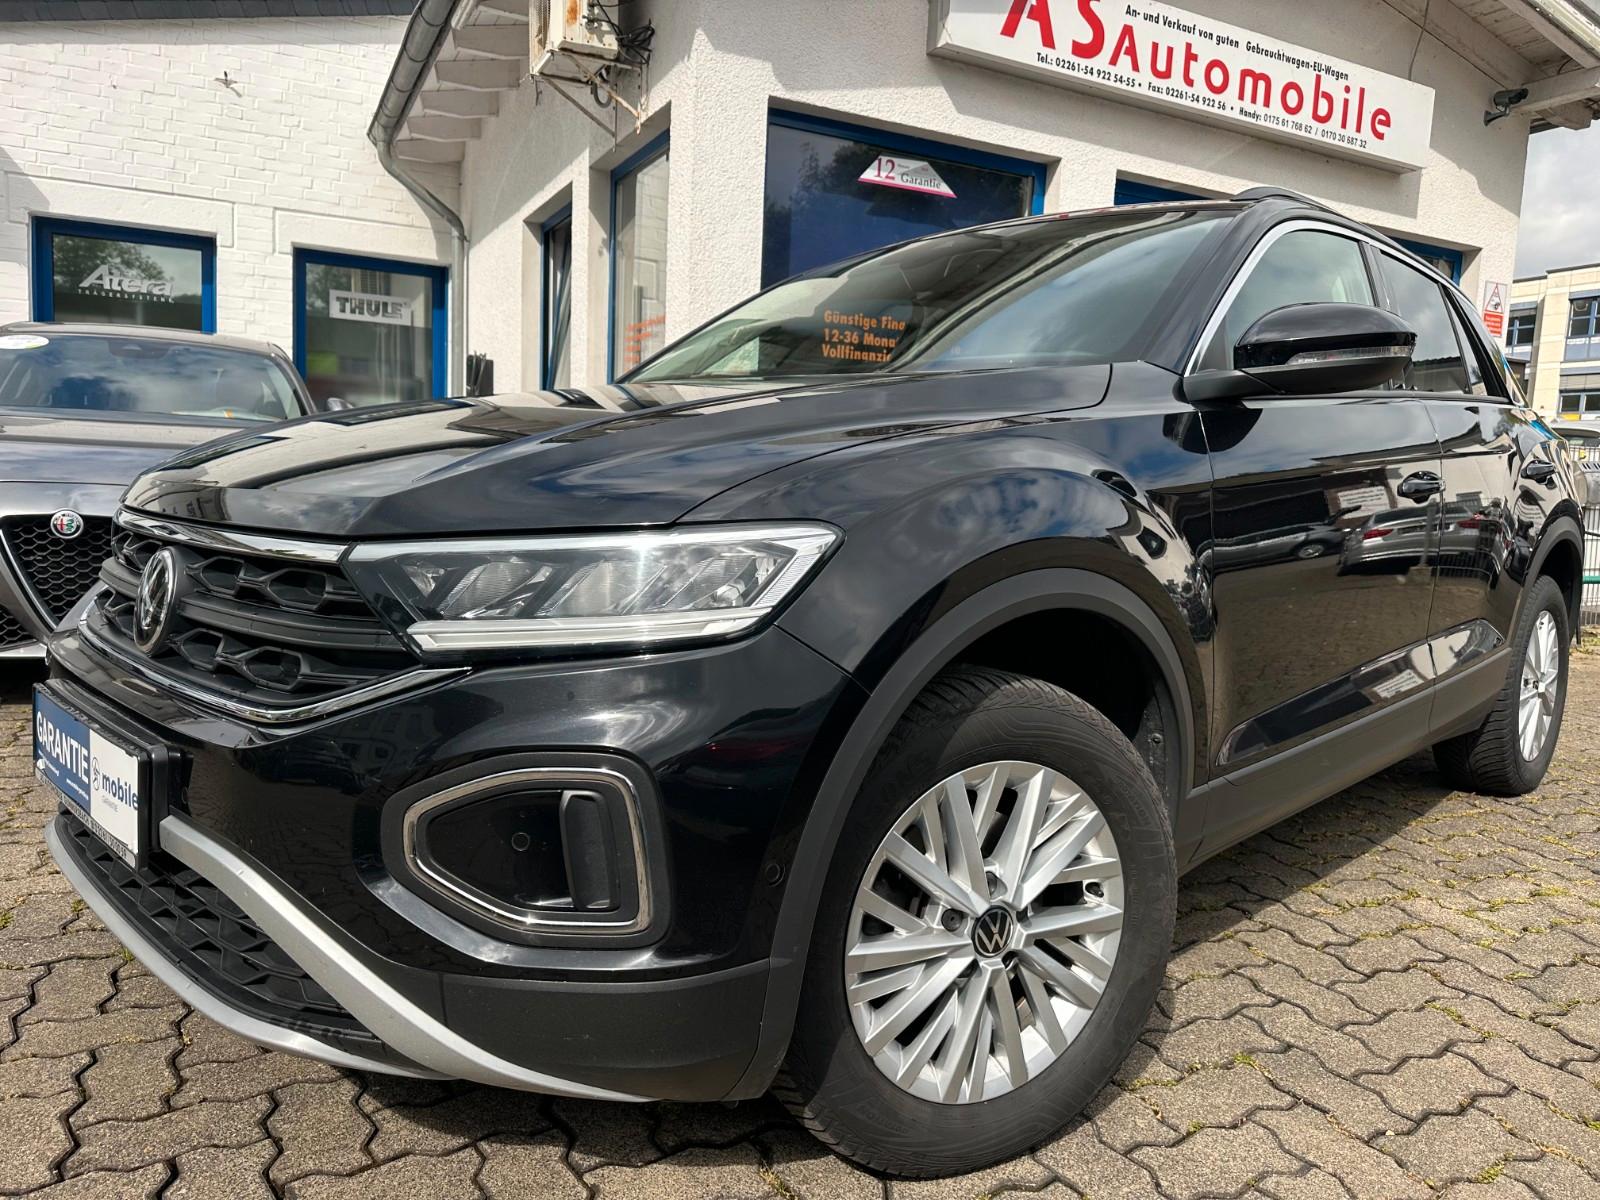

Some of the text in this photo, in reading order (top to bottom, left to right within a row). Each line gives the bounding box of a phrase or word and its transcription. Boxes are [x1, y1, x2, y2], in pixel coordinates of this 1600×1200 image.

[1125, 4, 1350, 81] An- und Verkauf von guten Gebrauchtwagen-EU-Wagen
[1036, 52, 1054, 66] Tel.:
[1055, 58, 1095, 77] 02261-54
[1096, 69, 1112, 82] 922
[1113, 73, 1136, 88] 54-55
[1147, 81, 1164, 95] Fax:
[1165, 86, 1200, 104] 02261-54
[1201, 96, 1216, 108] 922
[1217, 100, 1227, 111] 56
[1238, 106, 1262, 123] Handy:
[1263, 113, 1280, 126] 0175
[1281, 118, 1289, 128] 61
[1304, 124, 1313, 135] 62
[1321, 129, 1337, 141] 0170
[1338, 133, 1346, 143] 30
[1359, 139, 1368, 149] 32
[874, 157, 896, 180] 12
[900, 172, 941, 190] Garantie
[79, 264, 174, 297] Atera
[335, 296, 403, 319] THULE
[823, 310, 878, 331] Günstige
[823, 328, 899, 348] 12-36 Mona
[36, 711, 90, 785] GARANTIE
